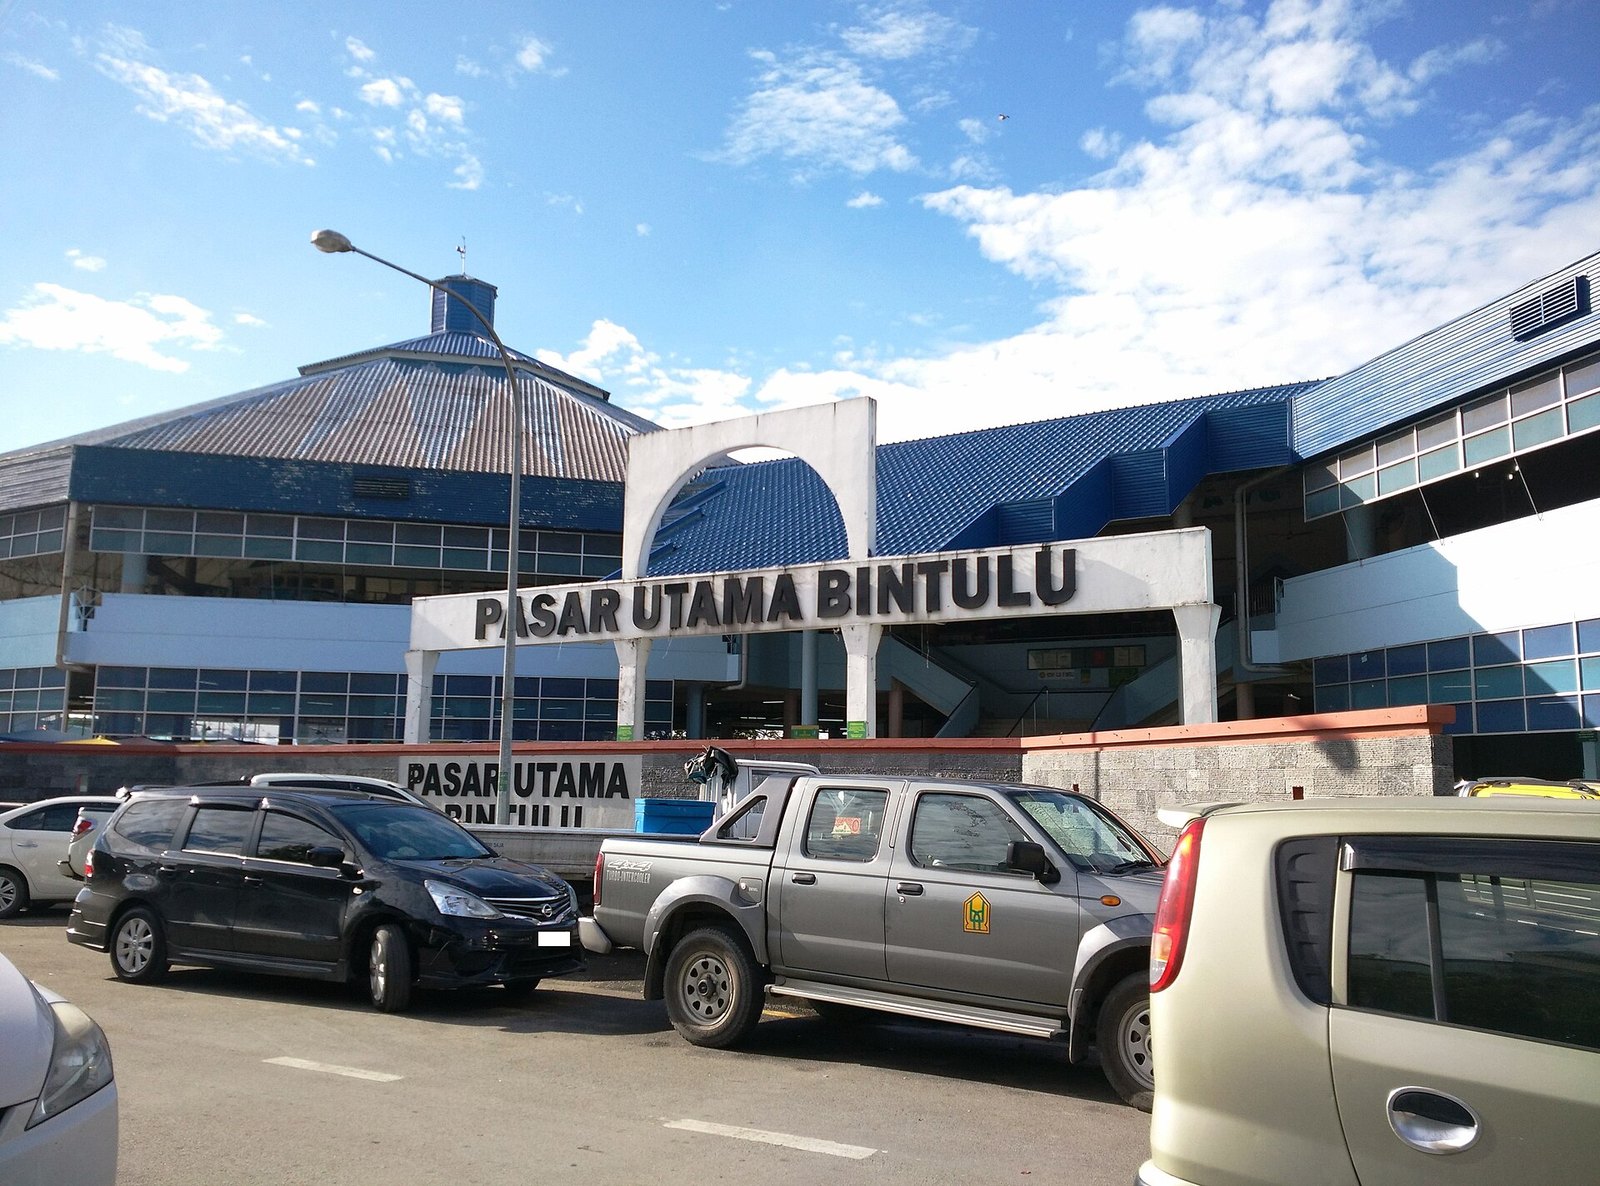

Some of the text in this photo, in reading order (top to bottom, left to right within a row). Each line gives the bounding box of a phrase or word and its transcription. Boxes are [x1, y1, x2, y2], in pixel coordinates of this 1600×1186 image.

[475, 548, 1077, 640] PASAR UTAMA BINTULU
[407, 762, 500, 797] PASAR
[514, 762, 630, 799] UTAMA
